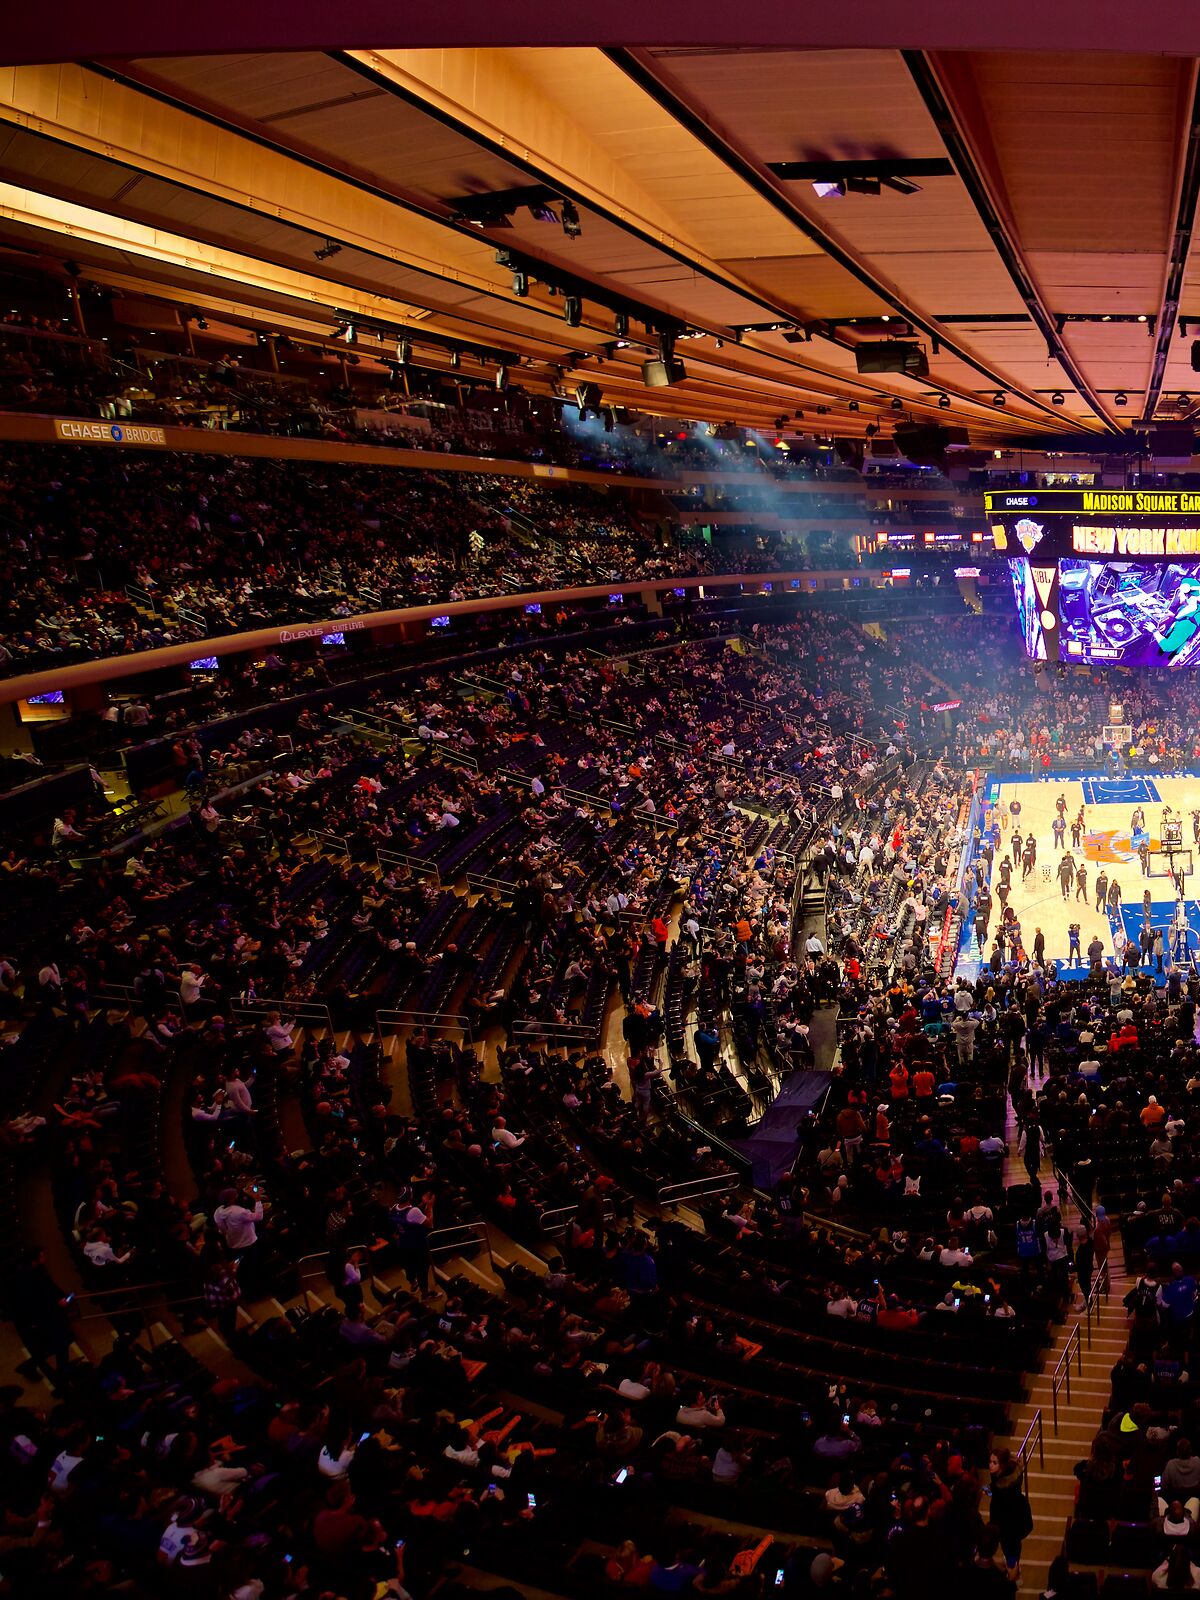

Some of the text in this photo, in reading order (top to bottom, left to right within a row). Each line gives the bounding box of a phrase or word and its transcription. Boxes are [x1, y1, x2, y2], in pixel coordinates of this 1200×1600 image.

[61, 423, 165, 443] CHASE BRIDGE
[1006, 497, 1028, 506] CHASE
[1083, 492, 1133, 511] MADISON
[1136, 492, 1178, 512] SQUARE
[1072, 525, 1116, 554] NEW
[1115, 527, 1165, 555] YORK
[292, 621, 365, 640] LEXUS SUITE LEVEL
